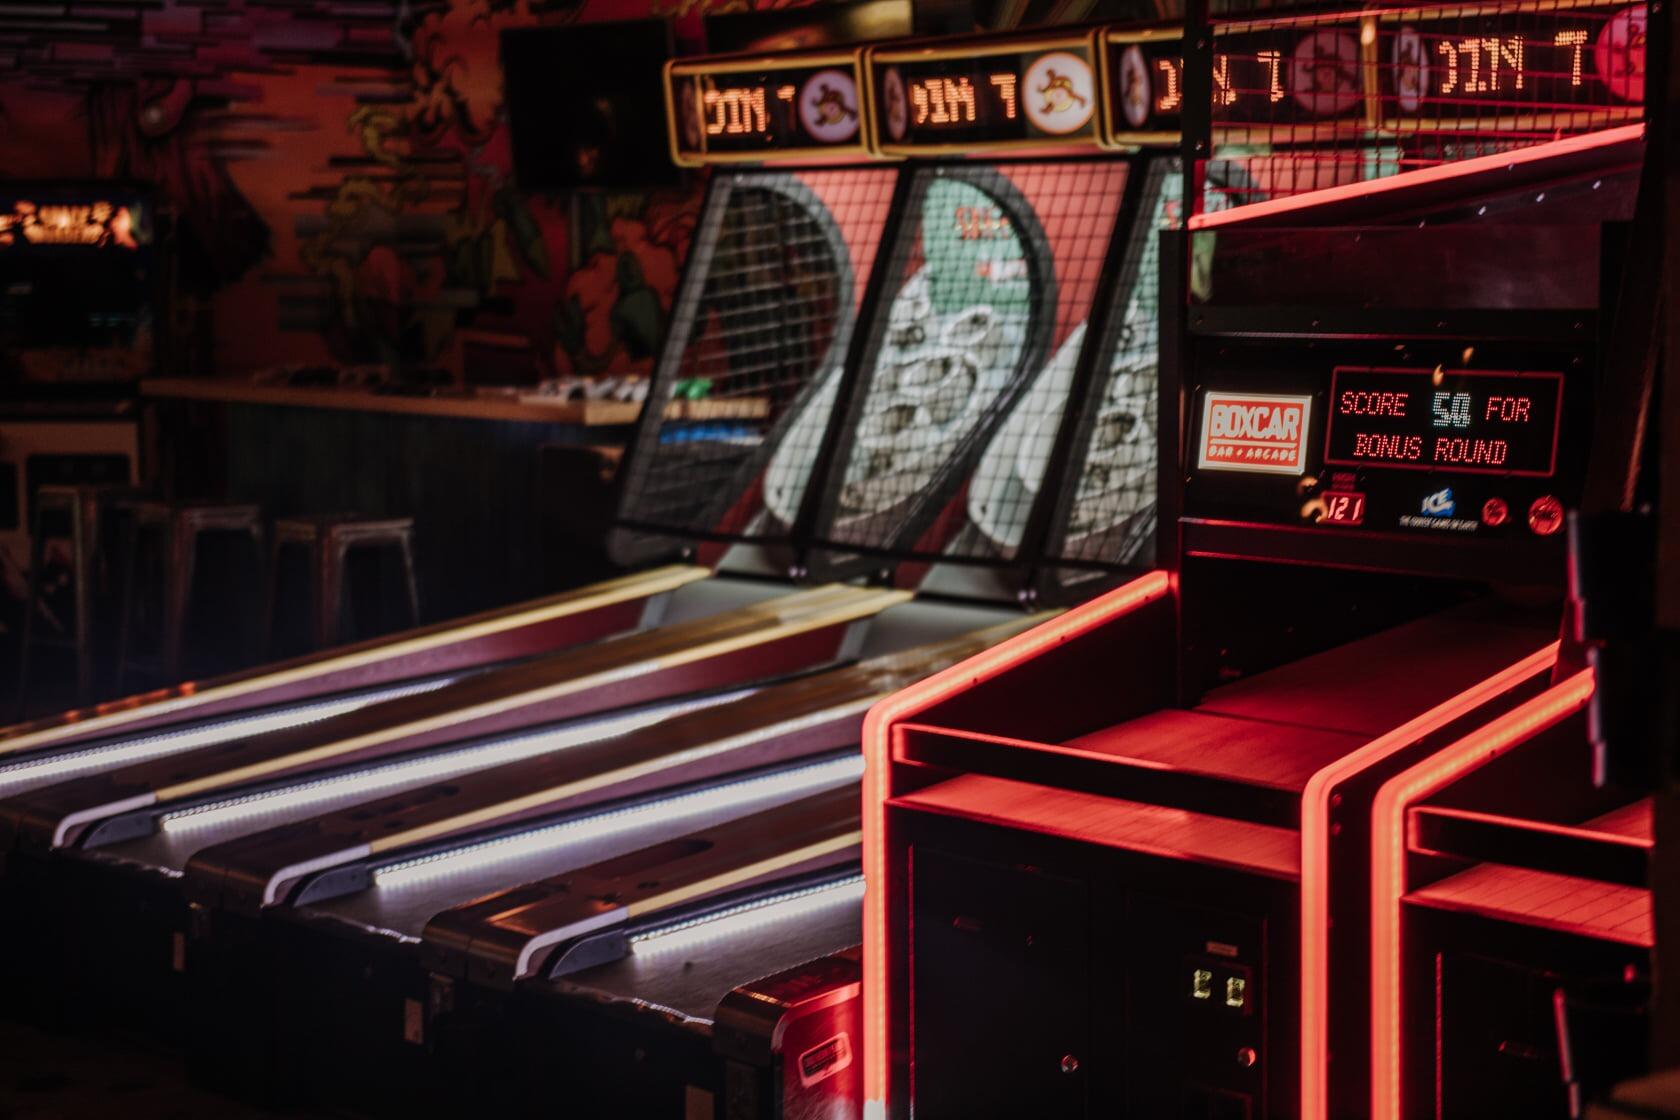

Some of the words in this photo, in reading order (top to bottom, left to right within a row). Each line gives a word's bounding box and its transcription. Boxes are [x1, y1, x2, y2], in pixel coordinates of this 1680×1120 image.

[1340, 391, 1409, 418] SCORE
[1485, 396, 1531, 423] FOR
[1210, 404, 1300, 441] BOXCAR
[1208, 444, 1234, 457] BAR
[1246, 446, 1297, 462] ARCADE
[1353, 433, 1422, 461] BONUS
[1433, 437, 1508, 465] ROUND
[1327, 496, 1362, 521] 121
[1420, 487, 1455, 515] ICE
